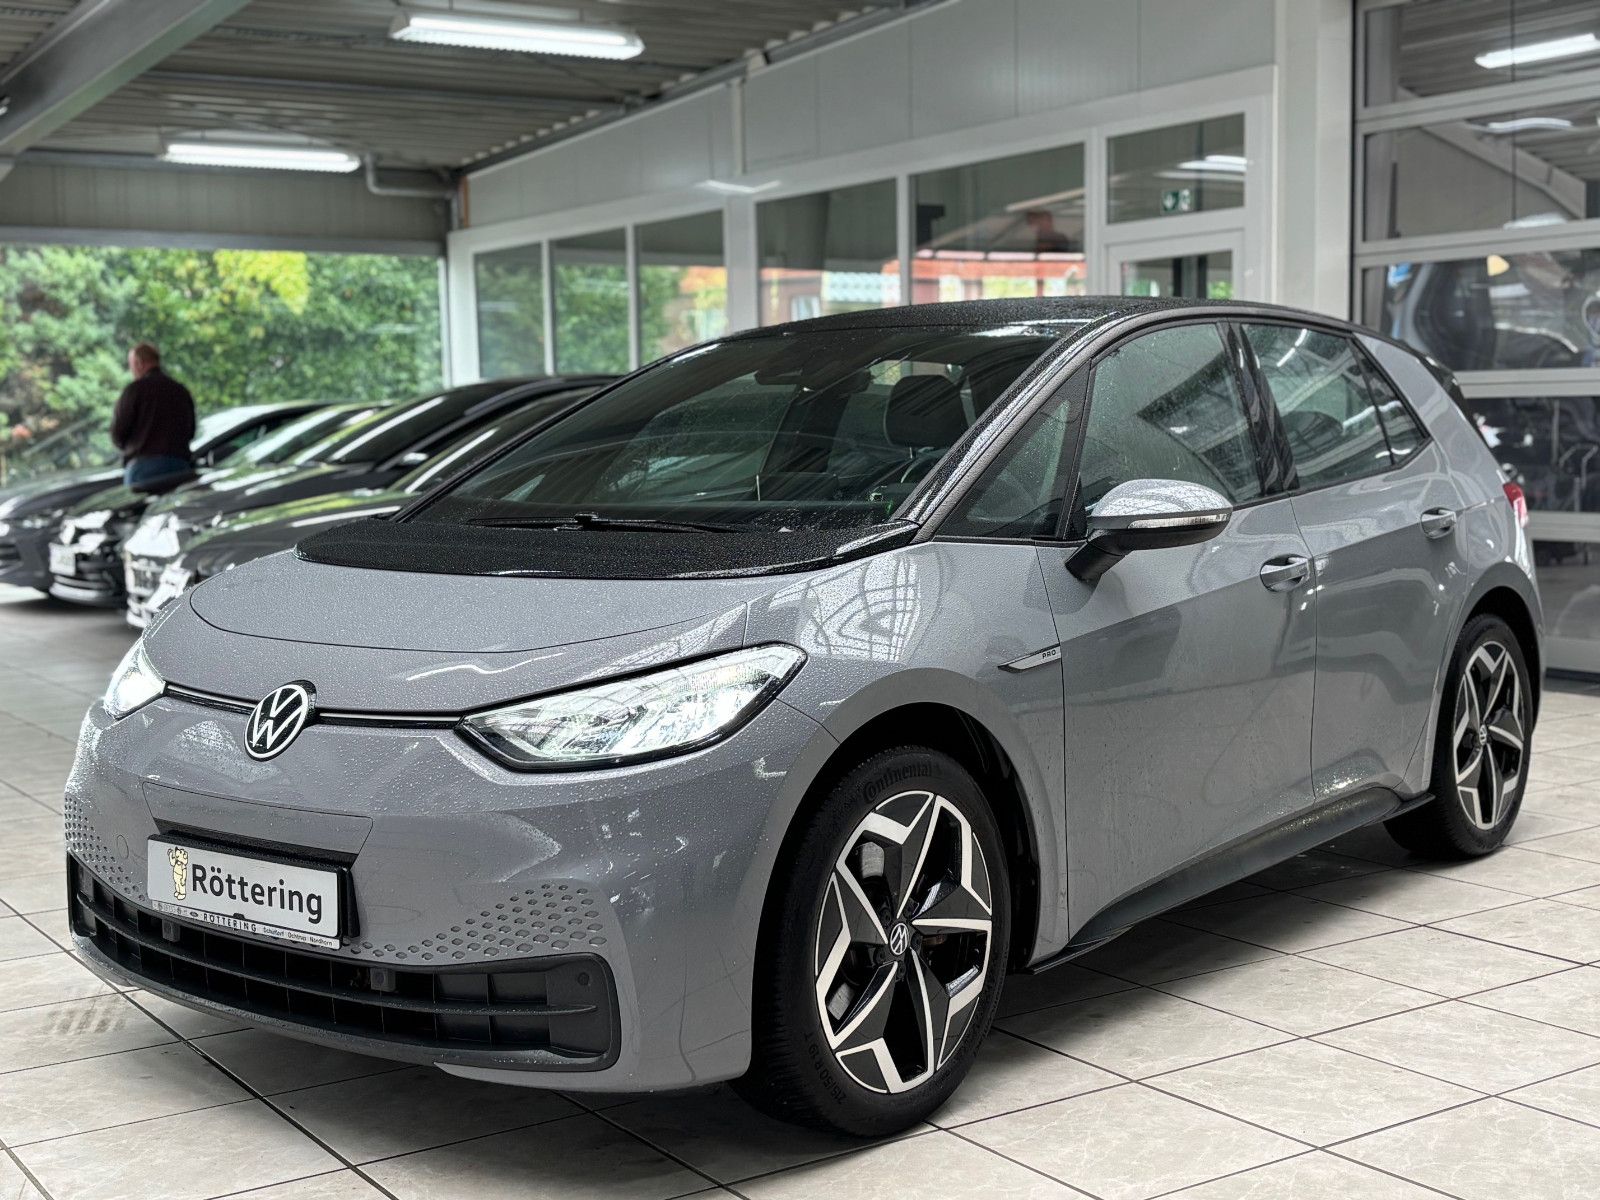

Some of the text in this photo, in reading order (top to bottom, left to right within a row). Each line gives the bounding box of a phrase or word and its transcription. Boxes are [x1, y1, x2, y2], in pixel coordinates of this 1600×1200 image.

[1042, 649, 1057, 659] PRO
[245, 684, 309, 759] VW
[864, 761, 932, 804] Continental
[191, 863, 322, 925] Röttering
[203, 913, 257, 932] RÖTTERING
